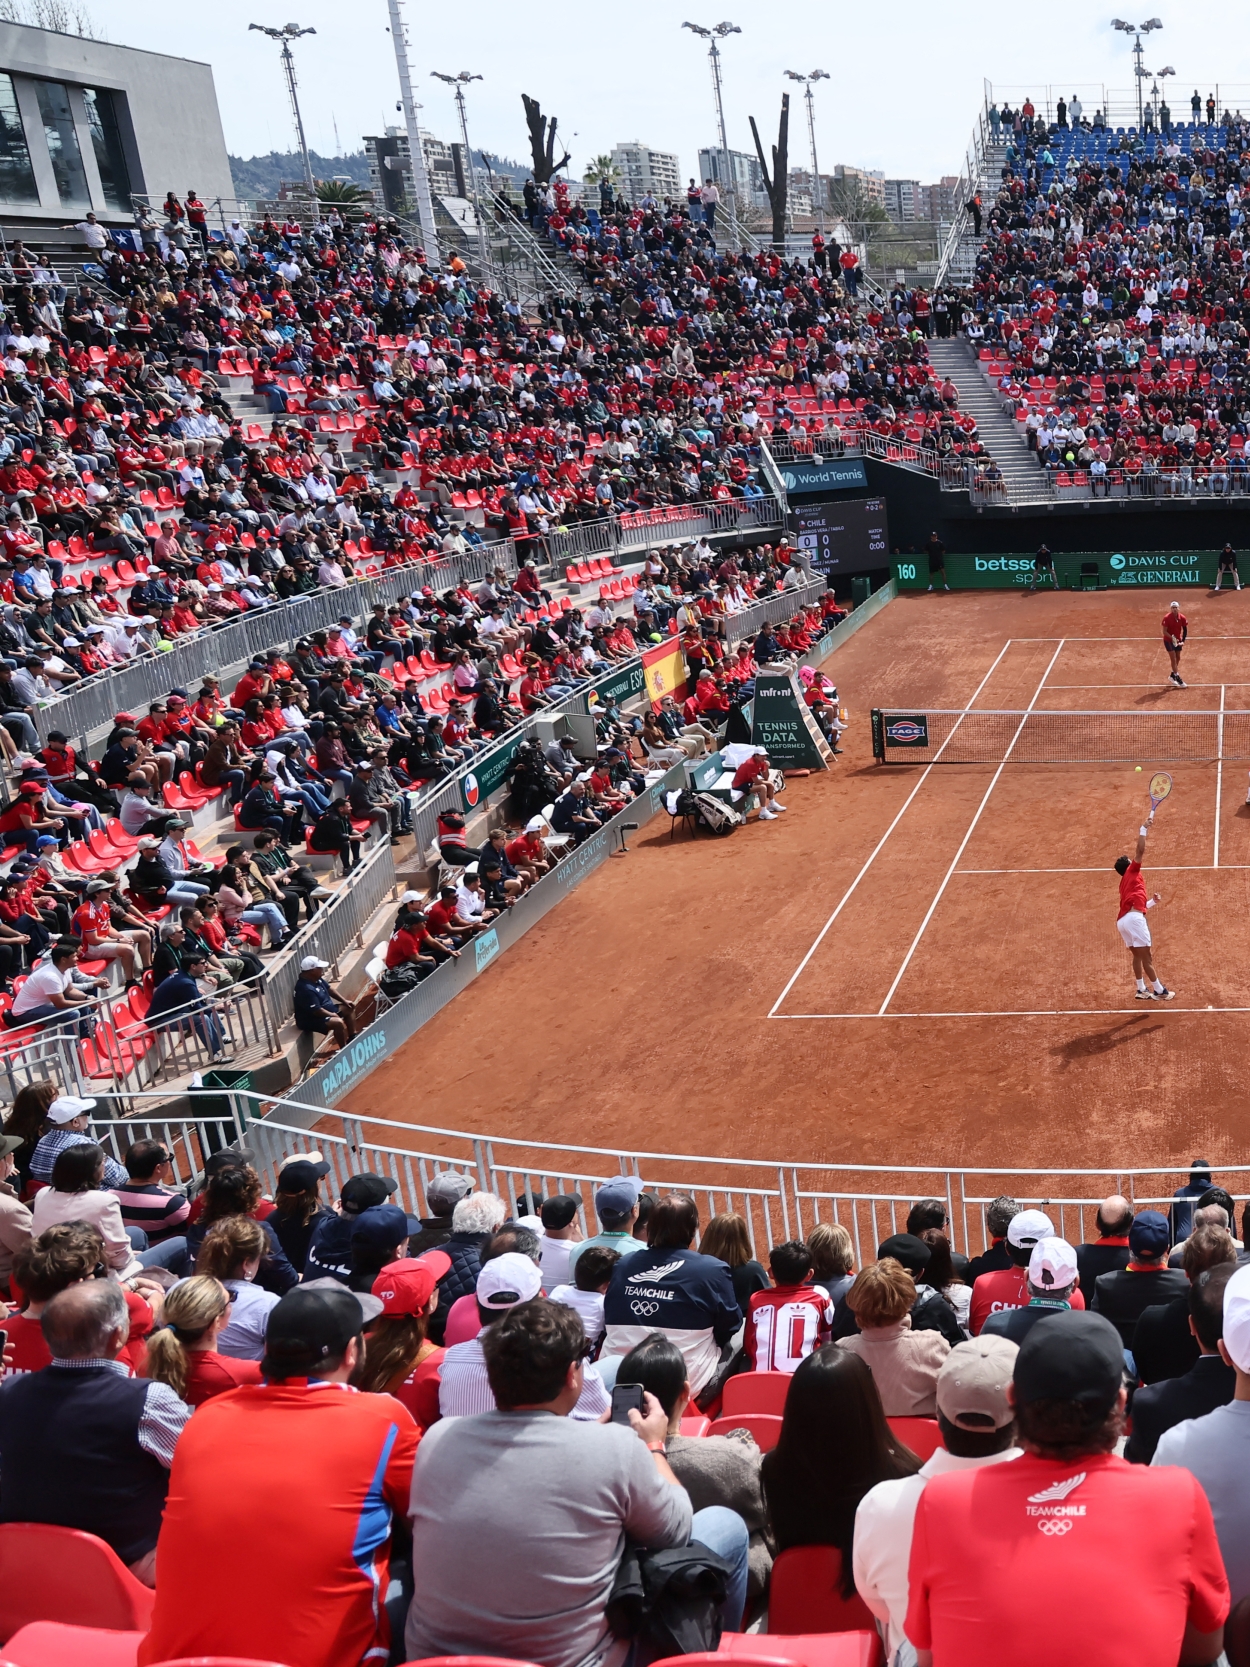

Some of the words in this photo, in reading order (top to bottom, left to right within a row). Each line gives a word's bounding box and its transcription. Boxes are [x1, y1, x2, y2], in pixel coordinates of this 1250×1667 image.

[798, 472, 830, 484] World
[830, 468, 863, 481] Tennis
[807, 519, 826, 527] CHILE
[804, 536, 811, 547] 0
[822, 534, 829, 545] 0
[869, 541, 885, 550] 0:00
[823, 548, 831, 559] 0
[1128, 556, 1167, 566] DAVIS
[1170, 555, 1198, 565] CUP
[897, 564, 916, 580] 160
[1110, 577, 1117, 585] by
[1137, 570, 1200, 583] GENERALI
[630, 668, 644, 691] ESP
[759, 687, 792, 697] infront
[757, 722, 798, 731] TENNIS
[762, 732, 797, 742] DATA
[756, 742, 806, 750] TRANSFORMED
[556, 856, 578, 884] HYATT
[578, 832, 607, 866] CENTRIC
[321, 1055, 352, 1098] PAPA
[350, 1029, 387, 1074] JOHNS
[624, 1285, 675, 1301] TEAMCHILE
[752, 1302, 821, 1374] 10
[1025, 1505, 1087, 1517] TEAMCHILE
